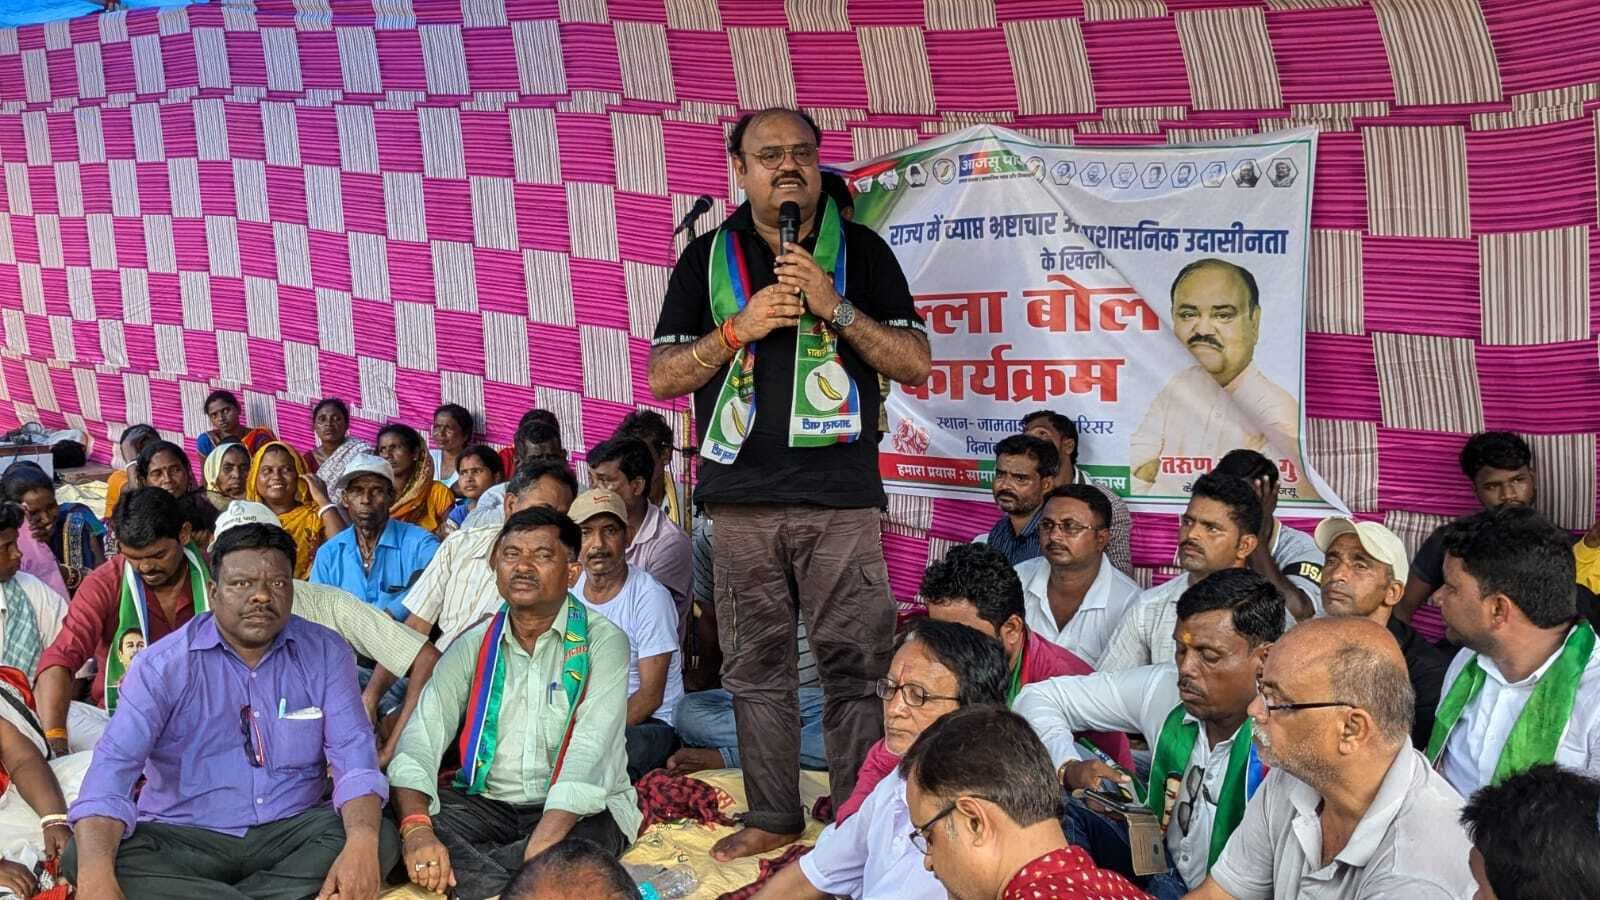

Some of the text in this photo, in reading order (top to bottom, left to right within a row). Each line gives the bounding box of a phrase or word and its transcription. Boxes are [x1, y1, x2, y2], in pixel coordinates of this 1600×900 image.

[960, 156, 1002, 172] आजसू
[889, 222, 925, 246] राज्य
[927, 214, 944, 242] में
[989, 212, 1058, 240] भ्रष्टाचार
[1184, 221, 1288, 254] उदासीनता
[1040, 246, 1115, 271] के खिला
[1022, 274, 1160, 332] बोल
[901, 344, 1125, 402] कार्यक्रम
[896, 463, 925, 477] हमारा
[927, 466, 956, 480] प्रयास
